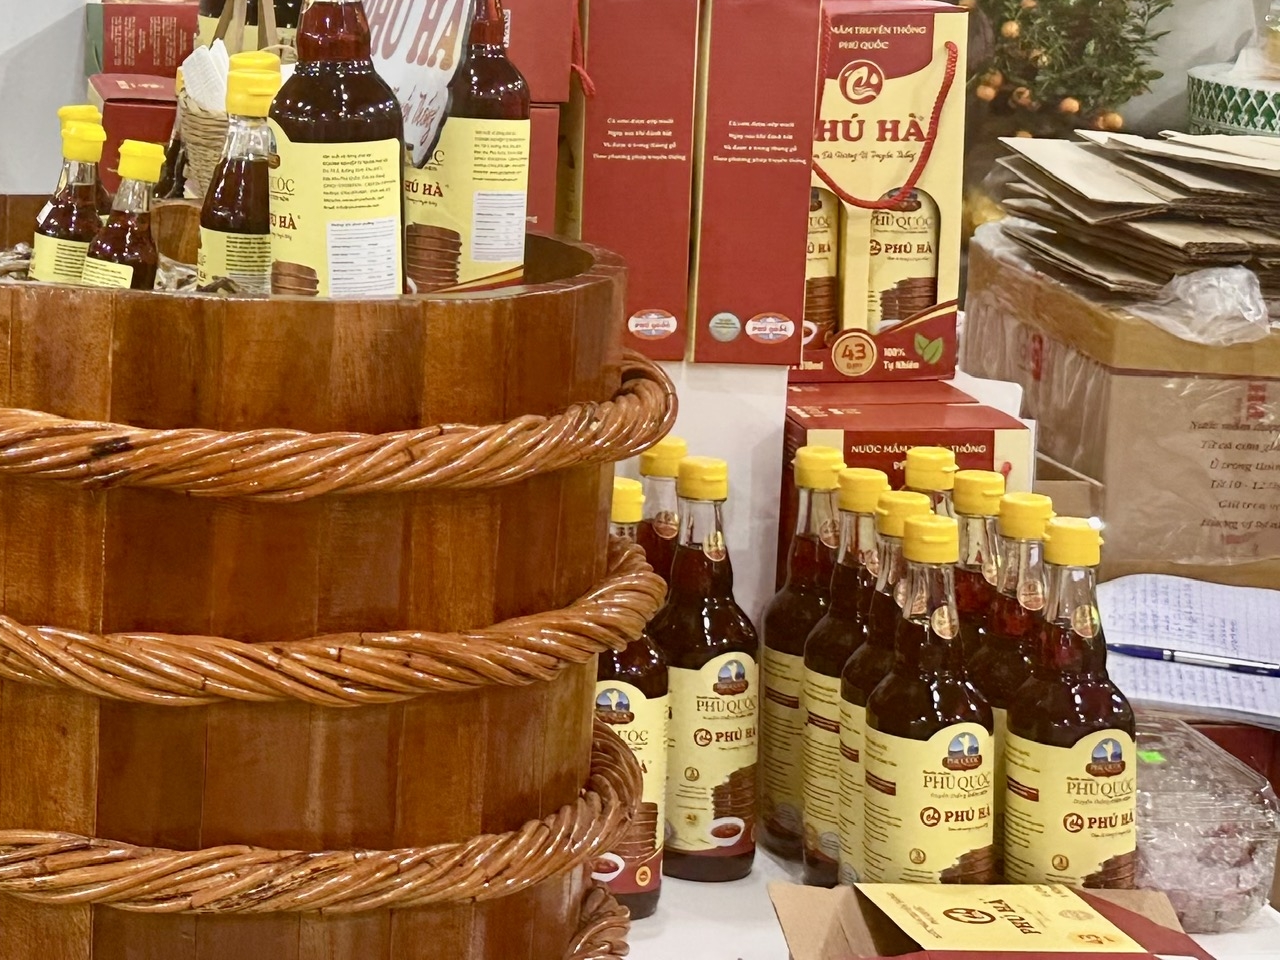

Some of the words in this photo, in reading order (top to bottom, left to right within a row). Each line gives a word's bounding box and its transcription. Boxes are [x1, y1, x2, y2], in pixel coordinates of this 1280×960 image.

[860, 39, 889, 50] QUỐC
[815, 113, 866, 142] HÚ
[876, 113, 926, 142] HÀ
[422, 182, 443, 198] HÀ
[278, 214, 297, 230] HÀ
[884, 243, 912, 254] PHÚ
[917, 242, 933, 254] HÀ
[842, 343, 866, 360] 43
[884, 348, 906, 357] 100%
[852, 444, 881, 453] NƯỚC
[618, 729, 649, 742] UỐC
[923, 773, 955, 790] PHÚ
[1066, 780, 1099, 795] PHÚ
[944, 807, 975, 822] PHÚ
[1087, 813, 1118, 829] PHÚ
